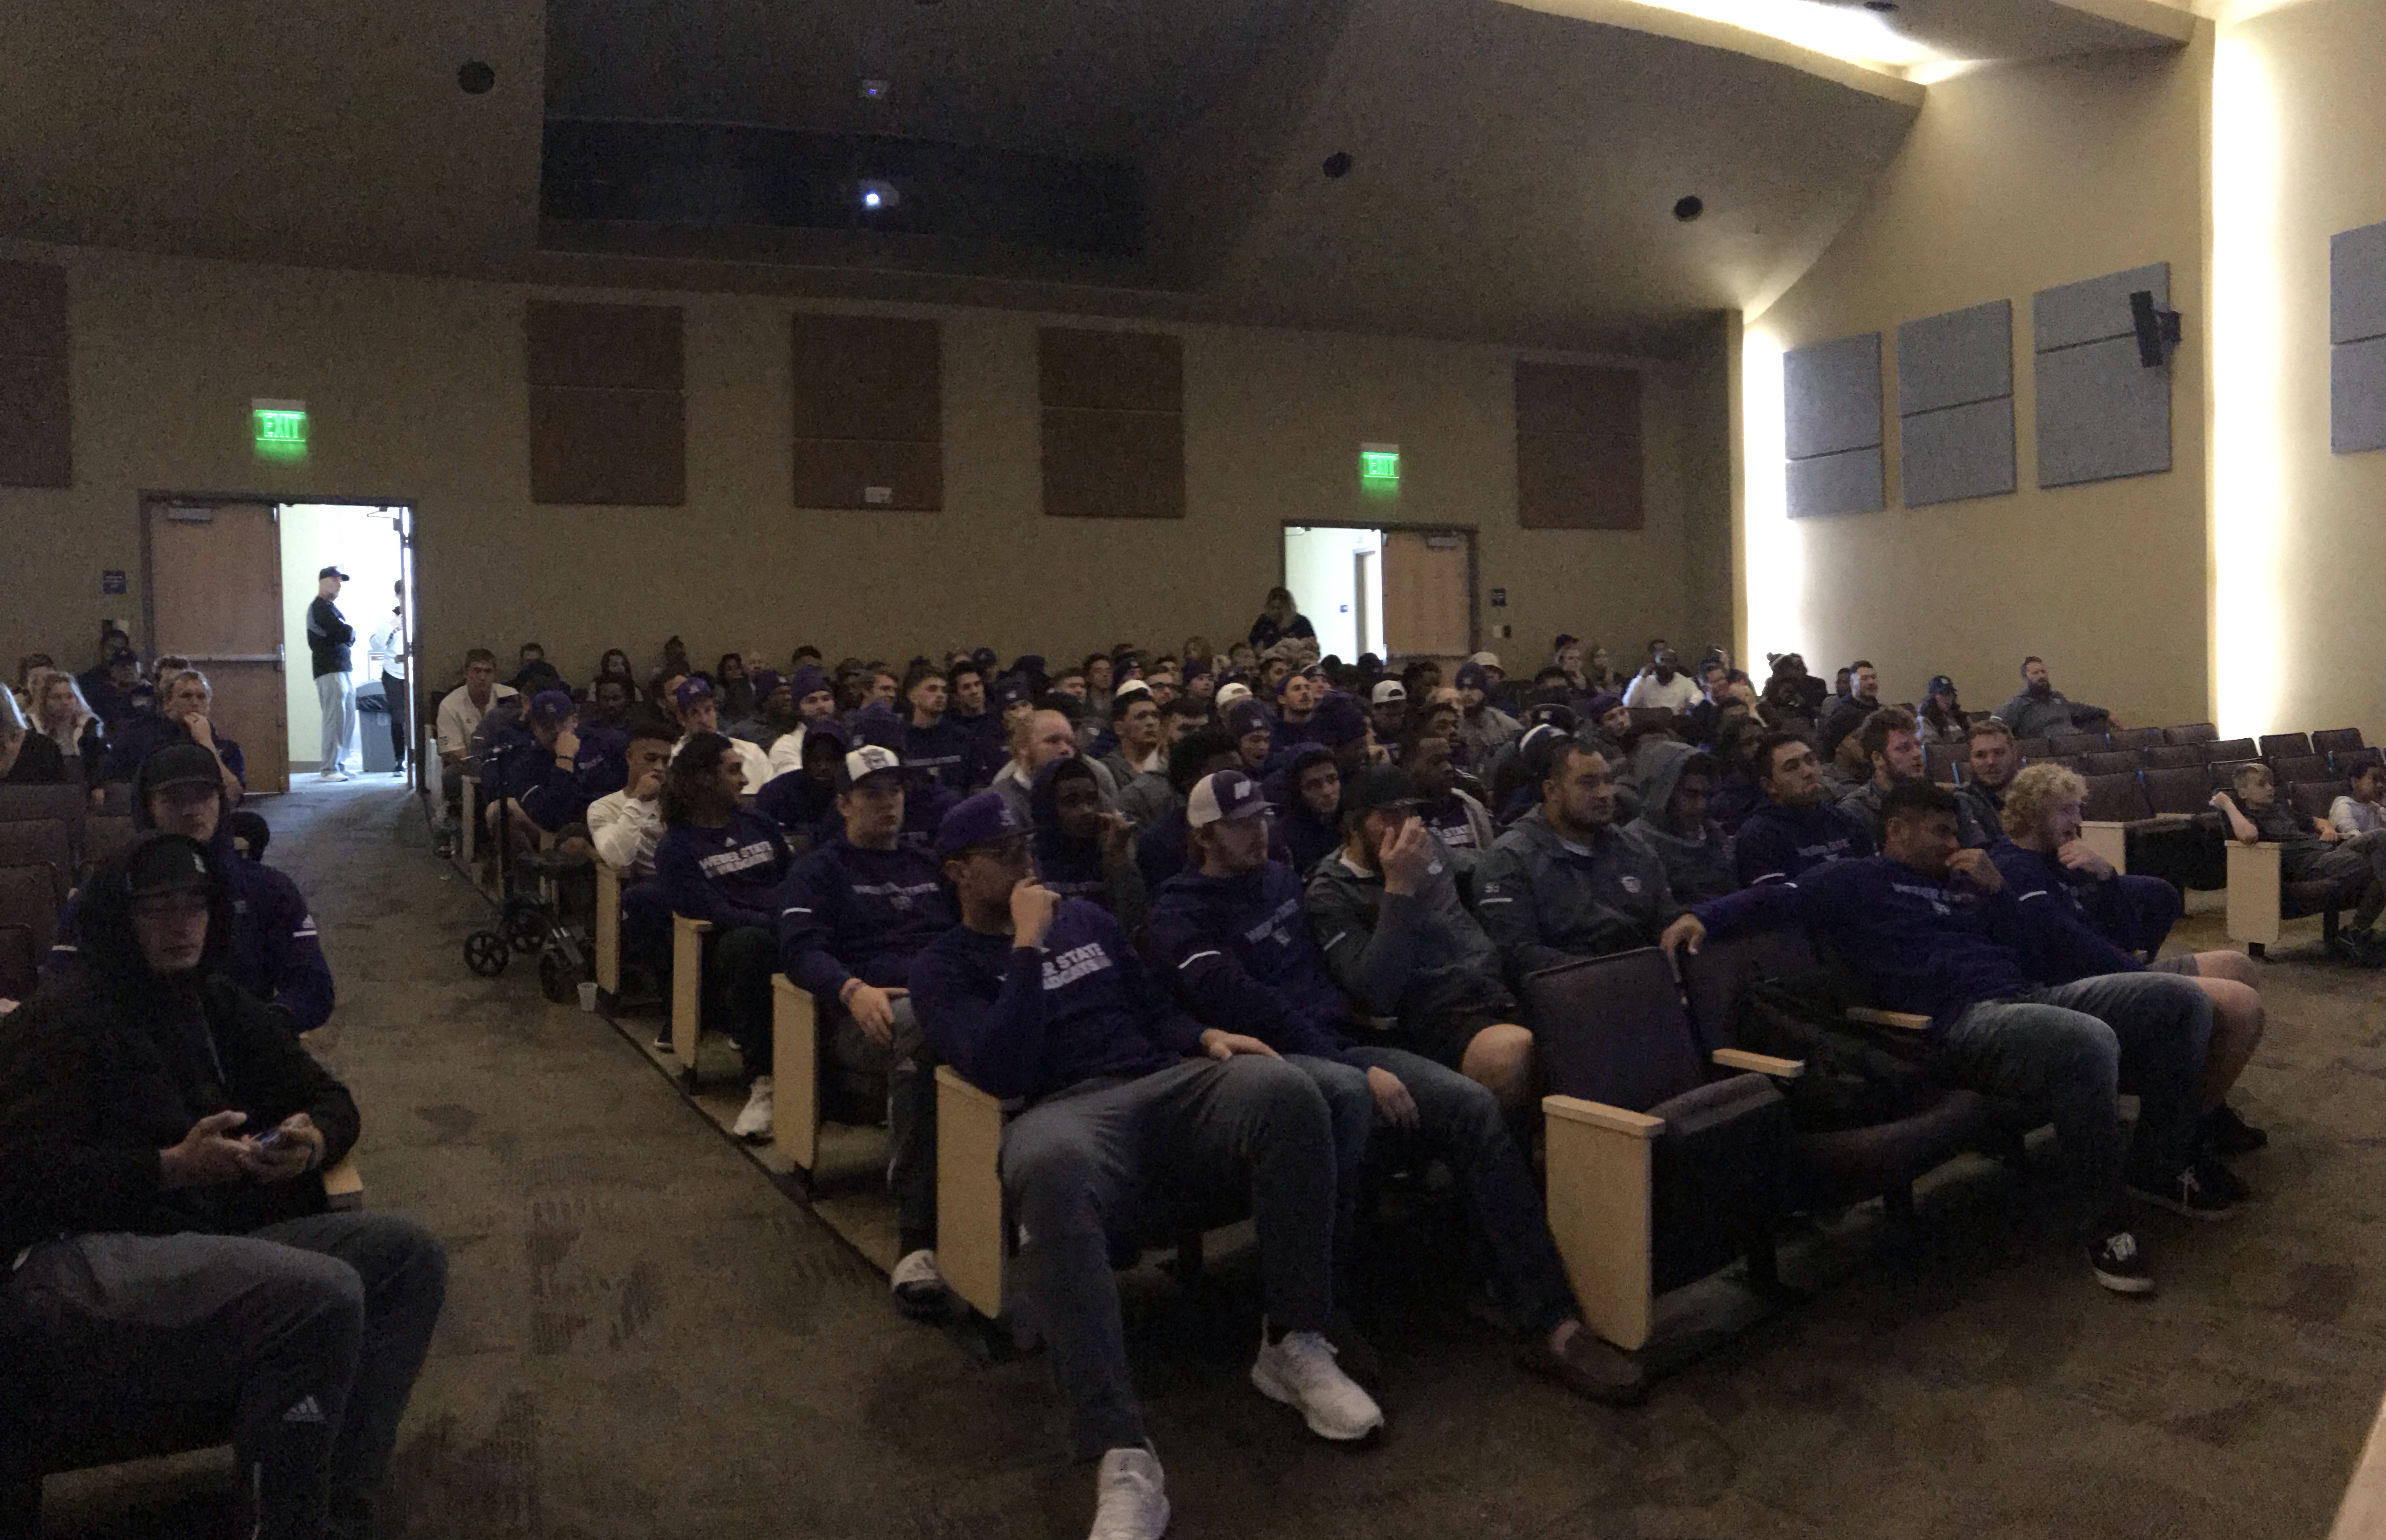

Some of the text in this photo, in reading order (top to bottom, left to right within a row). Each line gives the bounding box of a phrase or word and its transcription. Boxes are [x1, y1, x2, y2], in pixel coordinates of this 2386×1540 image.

[263, 412, 300, 439] EXIT
[1368, 454, 1396, 476] EXIT
[698, 841, 773, 870] WEBER STATE
[1055, 943, 1106, 969] STATE
